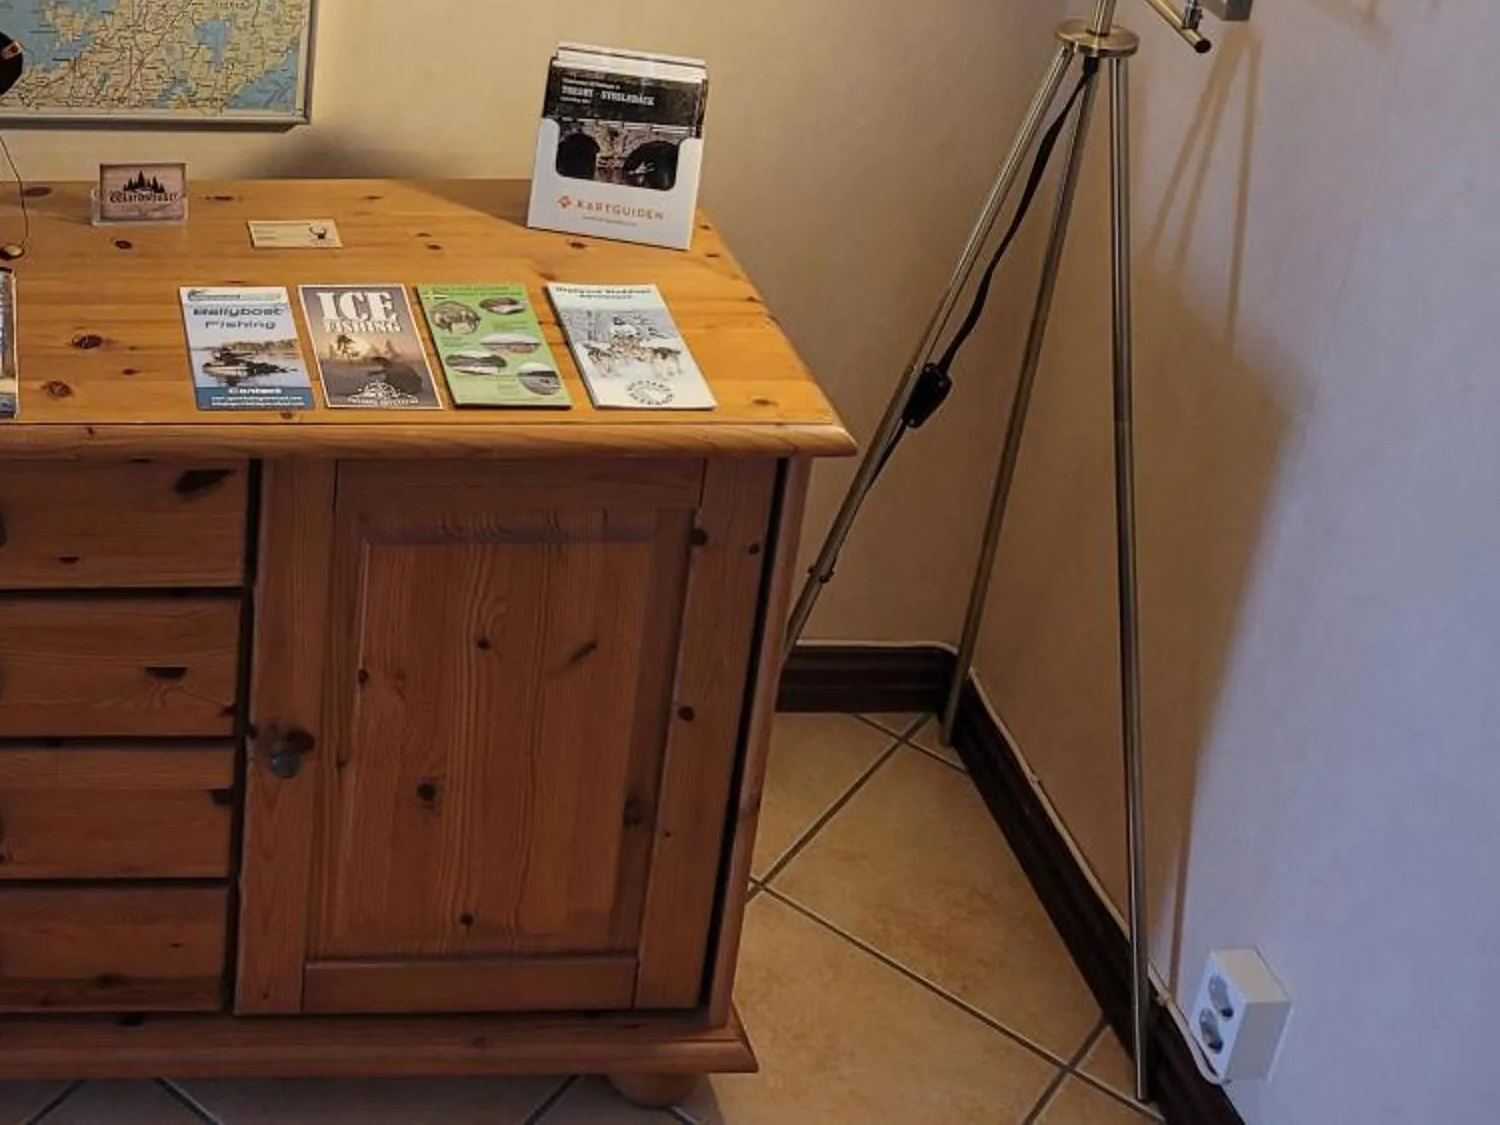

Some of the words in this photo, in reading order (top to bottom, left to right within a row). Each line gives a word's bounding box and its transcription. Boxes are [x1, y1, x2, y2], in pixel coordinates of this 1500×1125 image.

[577, 199, 664, 220] KARTGUIDEN
[316, 291, 398, 321] ICE
[205, 320, 276, 330] Fishing
